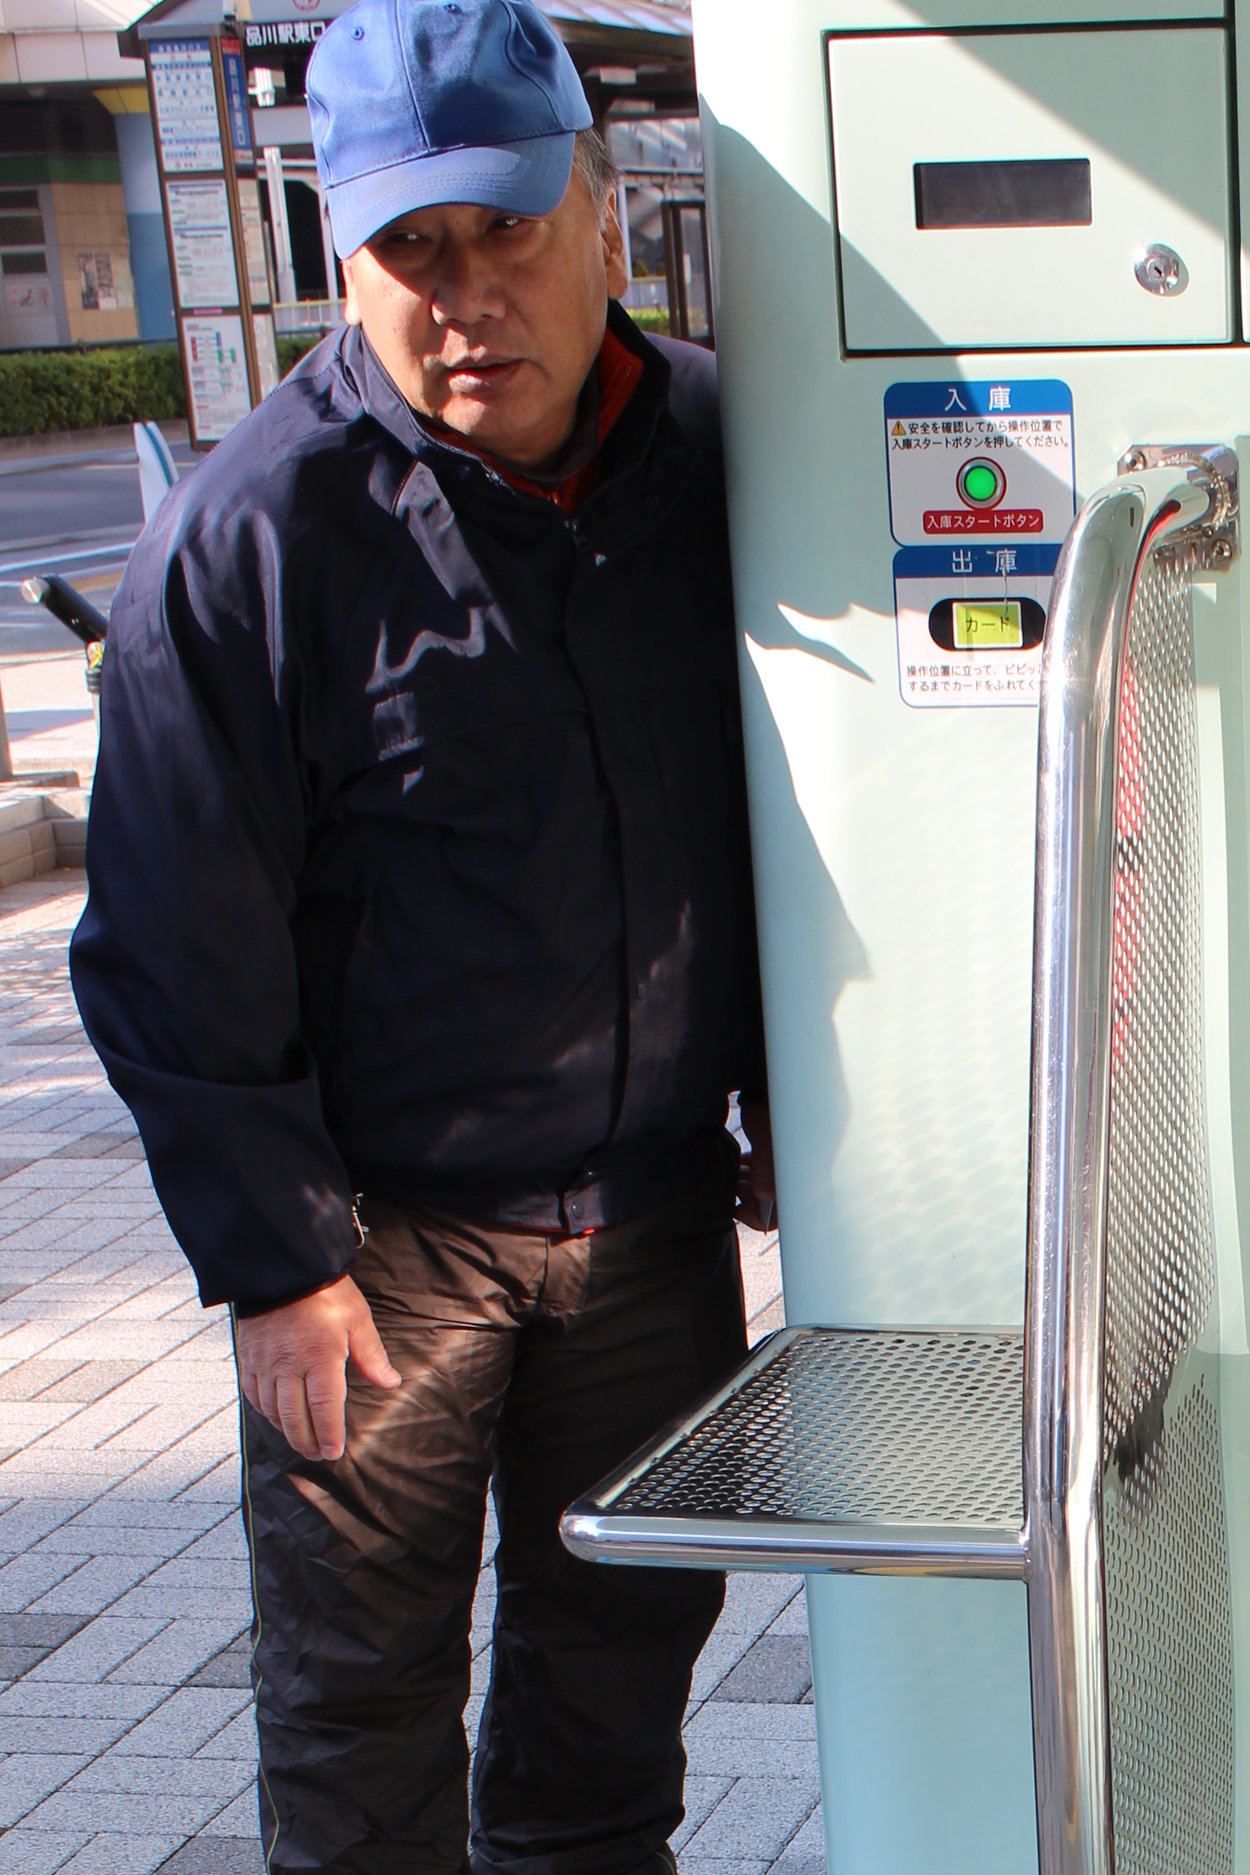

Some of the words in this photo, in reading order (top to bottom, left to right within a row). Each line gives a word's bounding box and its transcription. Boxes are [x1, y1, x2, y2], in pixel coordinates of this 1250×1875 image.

[246, 21, 326, 47] 品川駅東口
[908, 419, 1063, 436] 安全を確認してから操作位置で
[892, 435, 1069, 451] 入庫スタートボタンを押してください。
[927, 513, 1041, 530] 入庫スタートボタン
[965, 616, 1011, 633] カード
